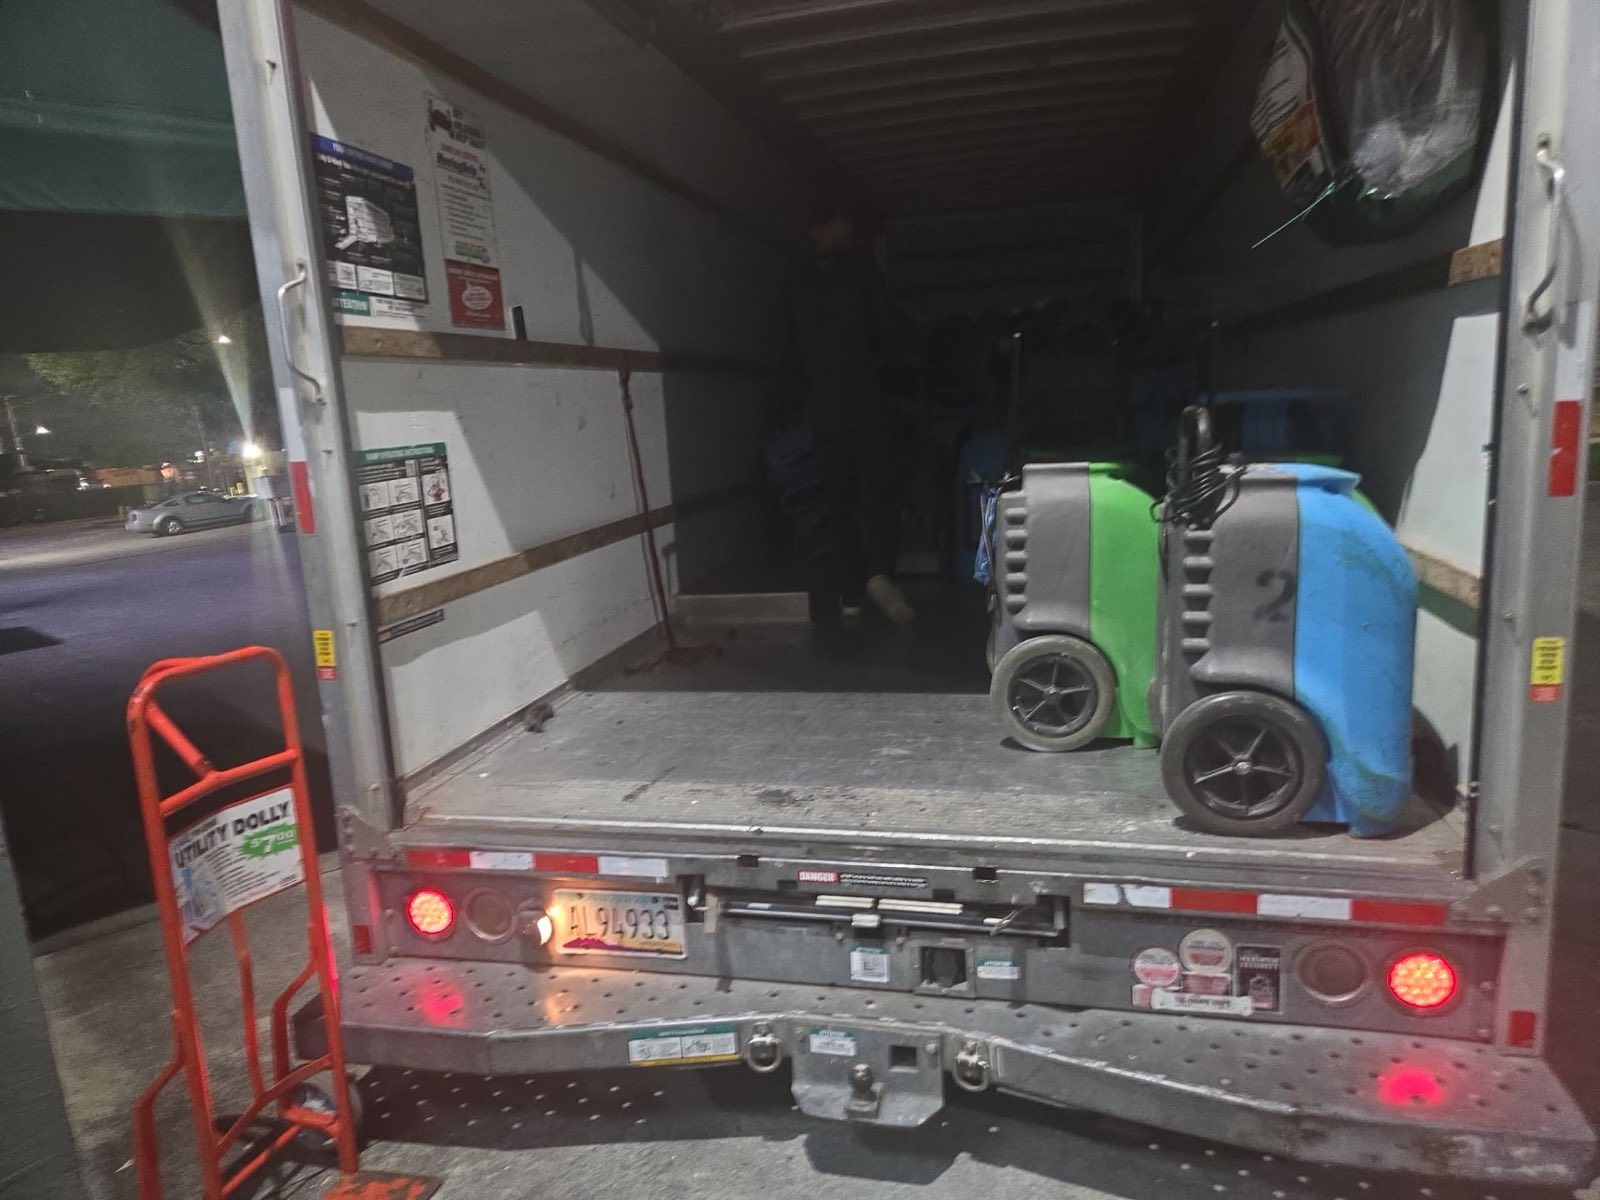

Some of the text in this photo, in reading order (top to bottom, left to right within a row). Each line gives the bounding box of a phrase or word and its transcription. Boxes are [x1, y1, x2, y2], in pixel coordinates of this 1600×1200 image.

[1255, 569, 1297, 623] 2
[174, 823, 228, 868] UTILITY
[232, 802, 290, 835] DOLLY
[799, 871, 835, 882] DANGER
